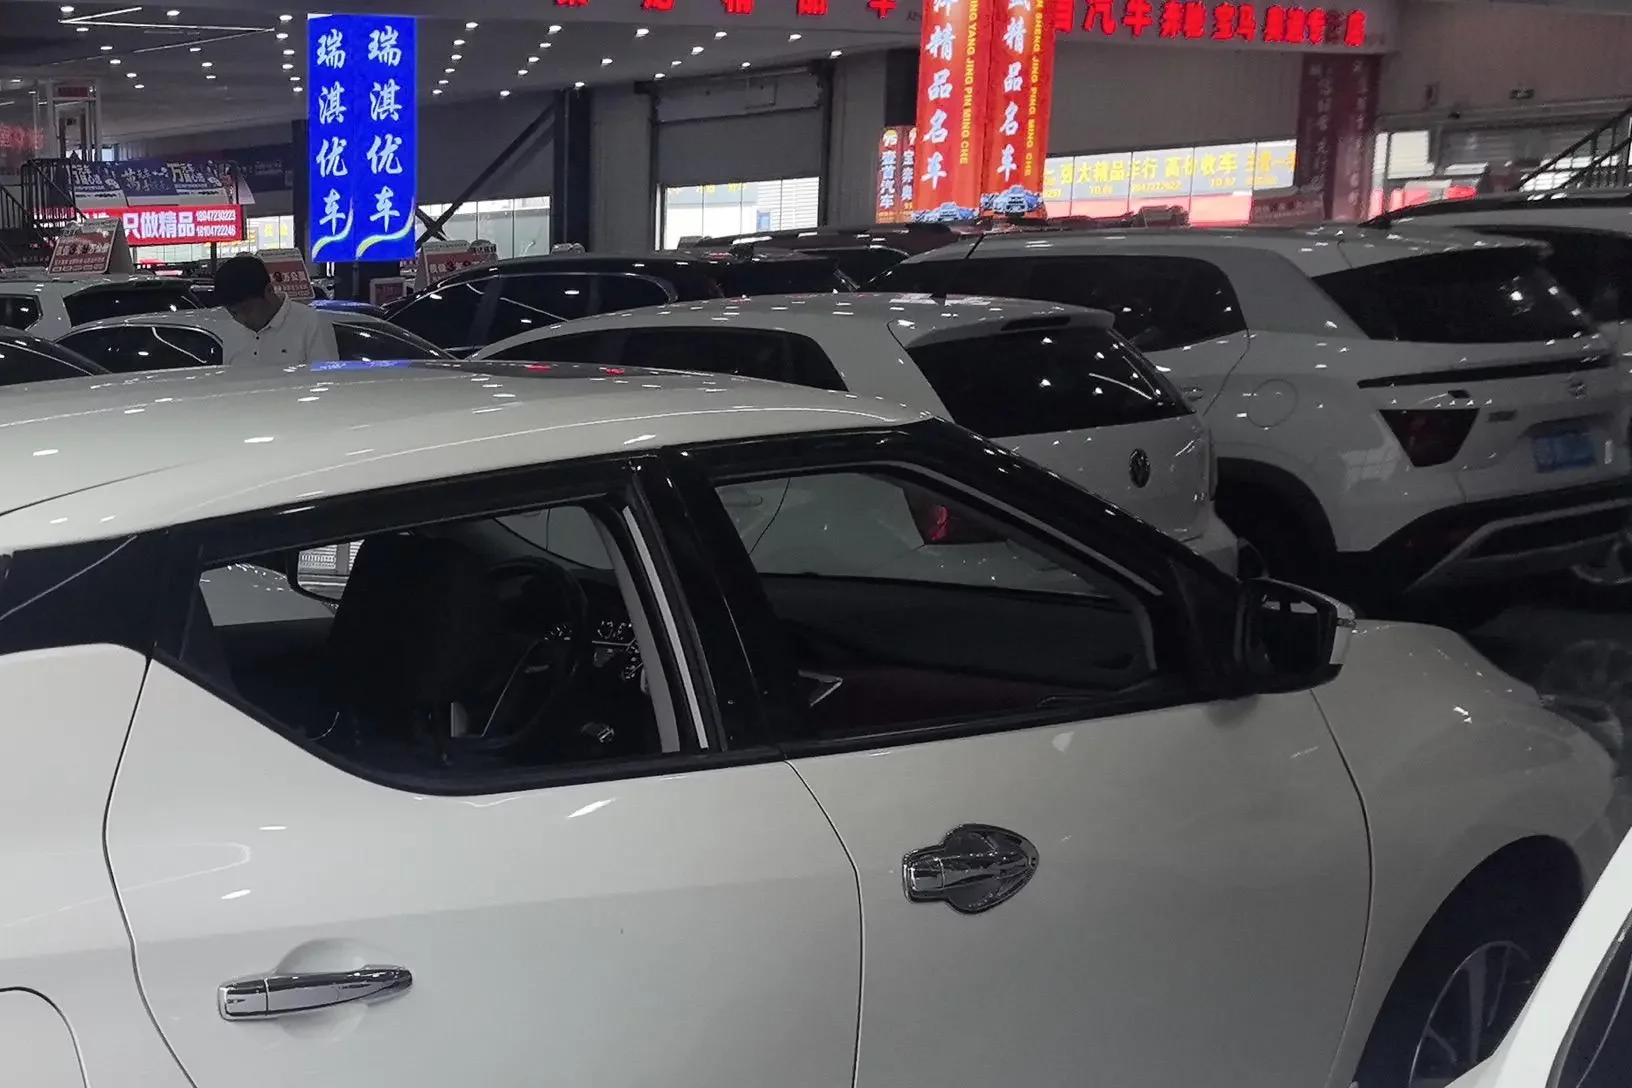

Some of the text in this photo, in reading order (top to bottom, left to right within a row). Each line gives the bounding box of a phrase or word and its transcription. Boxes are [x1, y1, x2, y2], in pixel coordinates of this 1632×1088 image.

[122, 211, 196, 239] 只做精品
[316, 27, 348, 237] 瑞淇优车
[366, 24, 403, 233] 瑞淇优车
